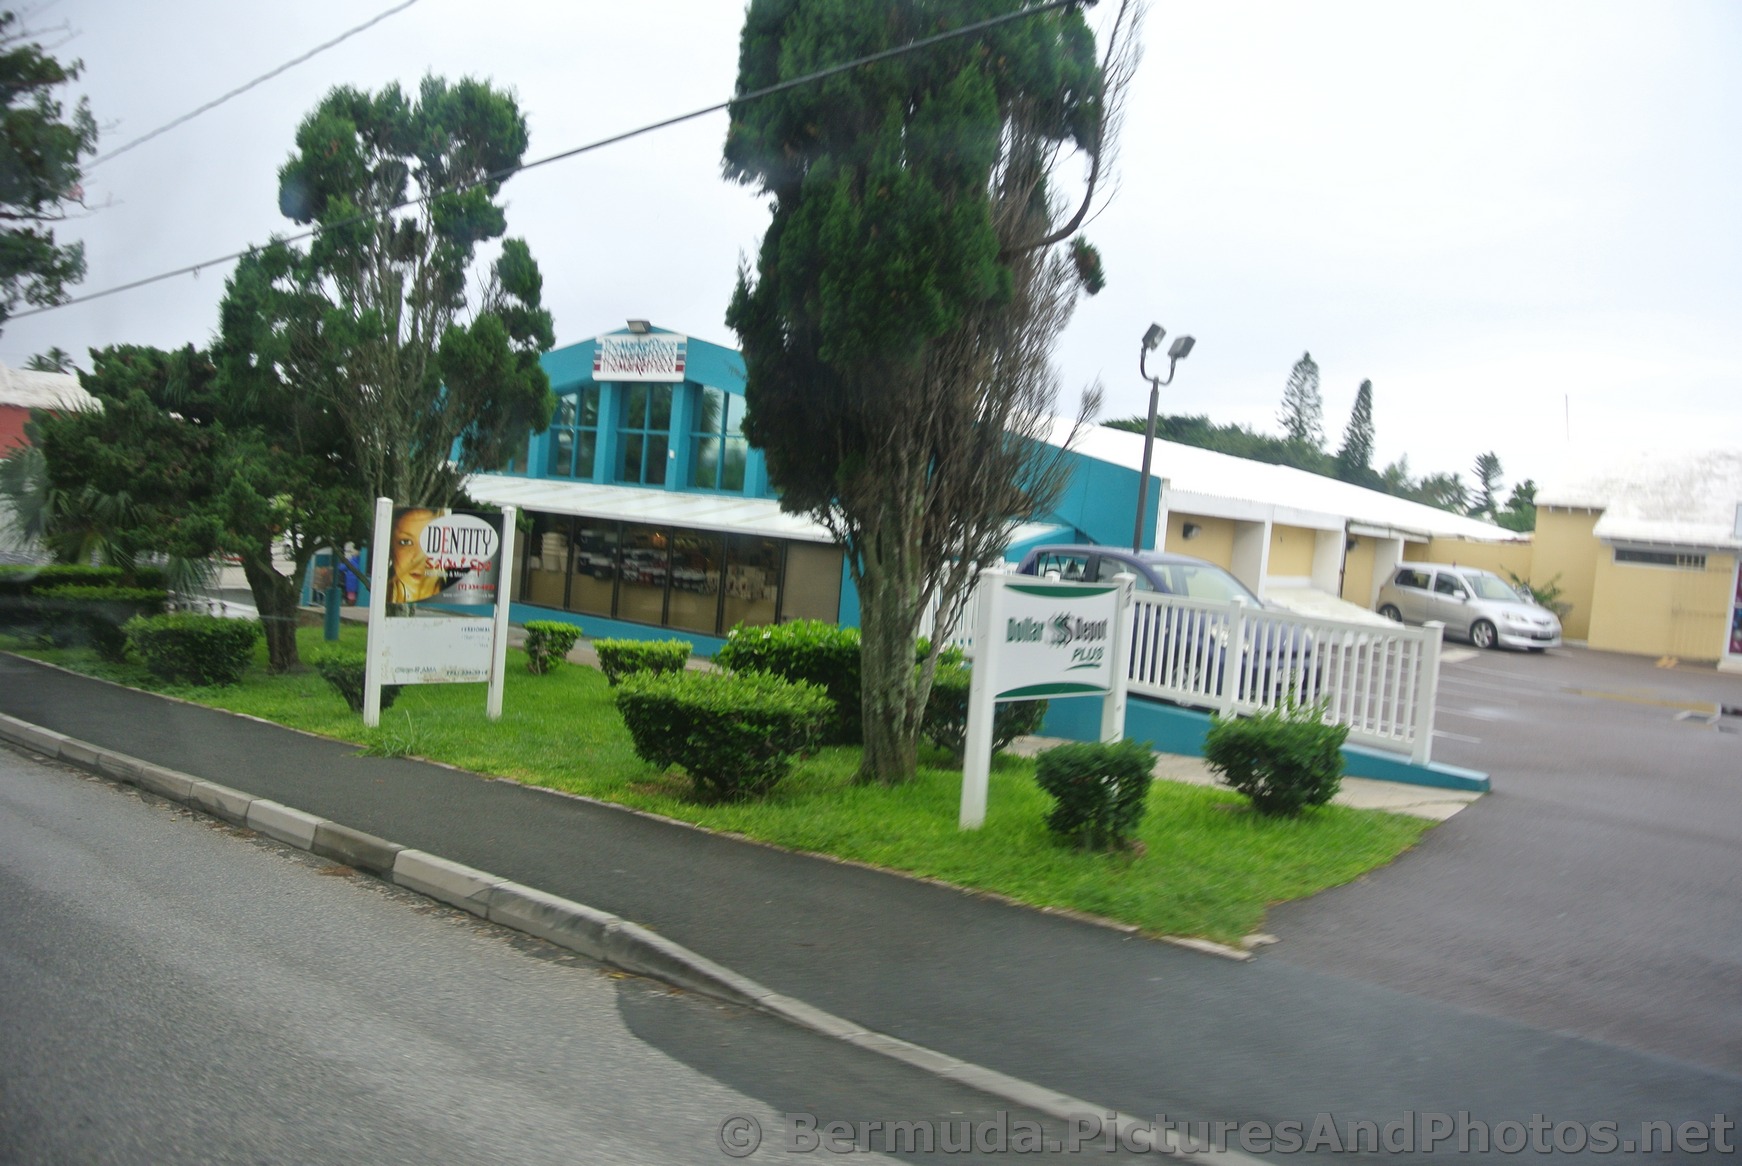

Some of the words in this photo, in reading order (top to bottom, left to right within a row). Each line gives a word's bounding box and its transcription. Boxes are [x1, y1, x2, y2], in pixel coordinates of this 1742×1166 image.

[426, 526, 492, 555] IDENTITY
[1006, 616, 1044, 643] Dollar
[1074, 616, 1108, 643] Depot
[1071, 646, 1104, 662] PLUS
